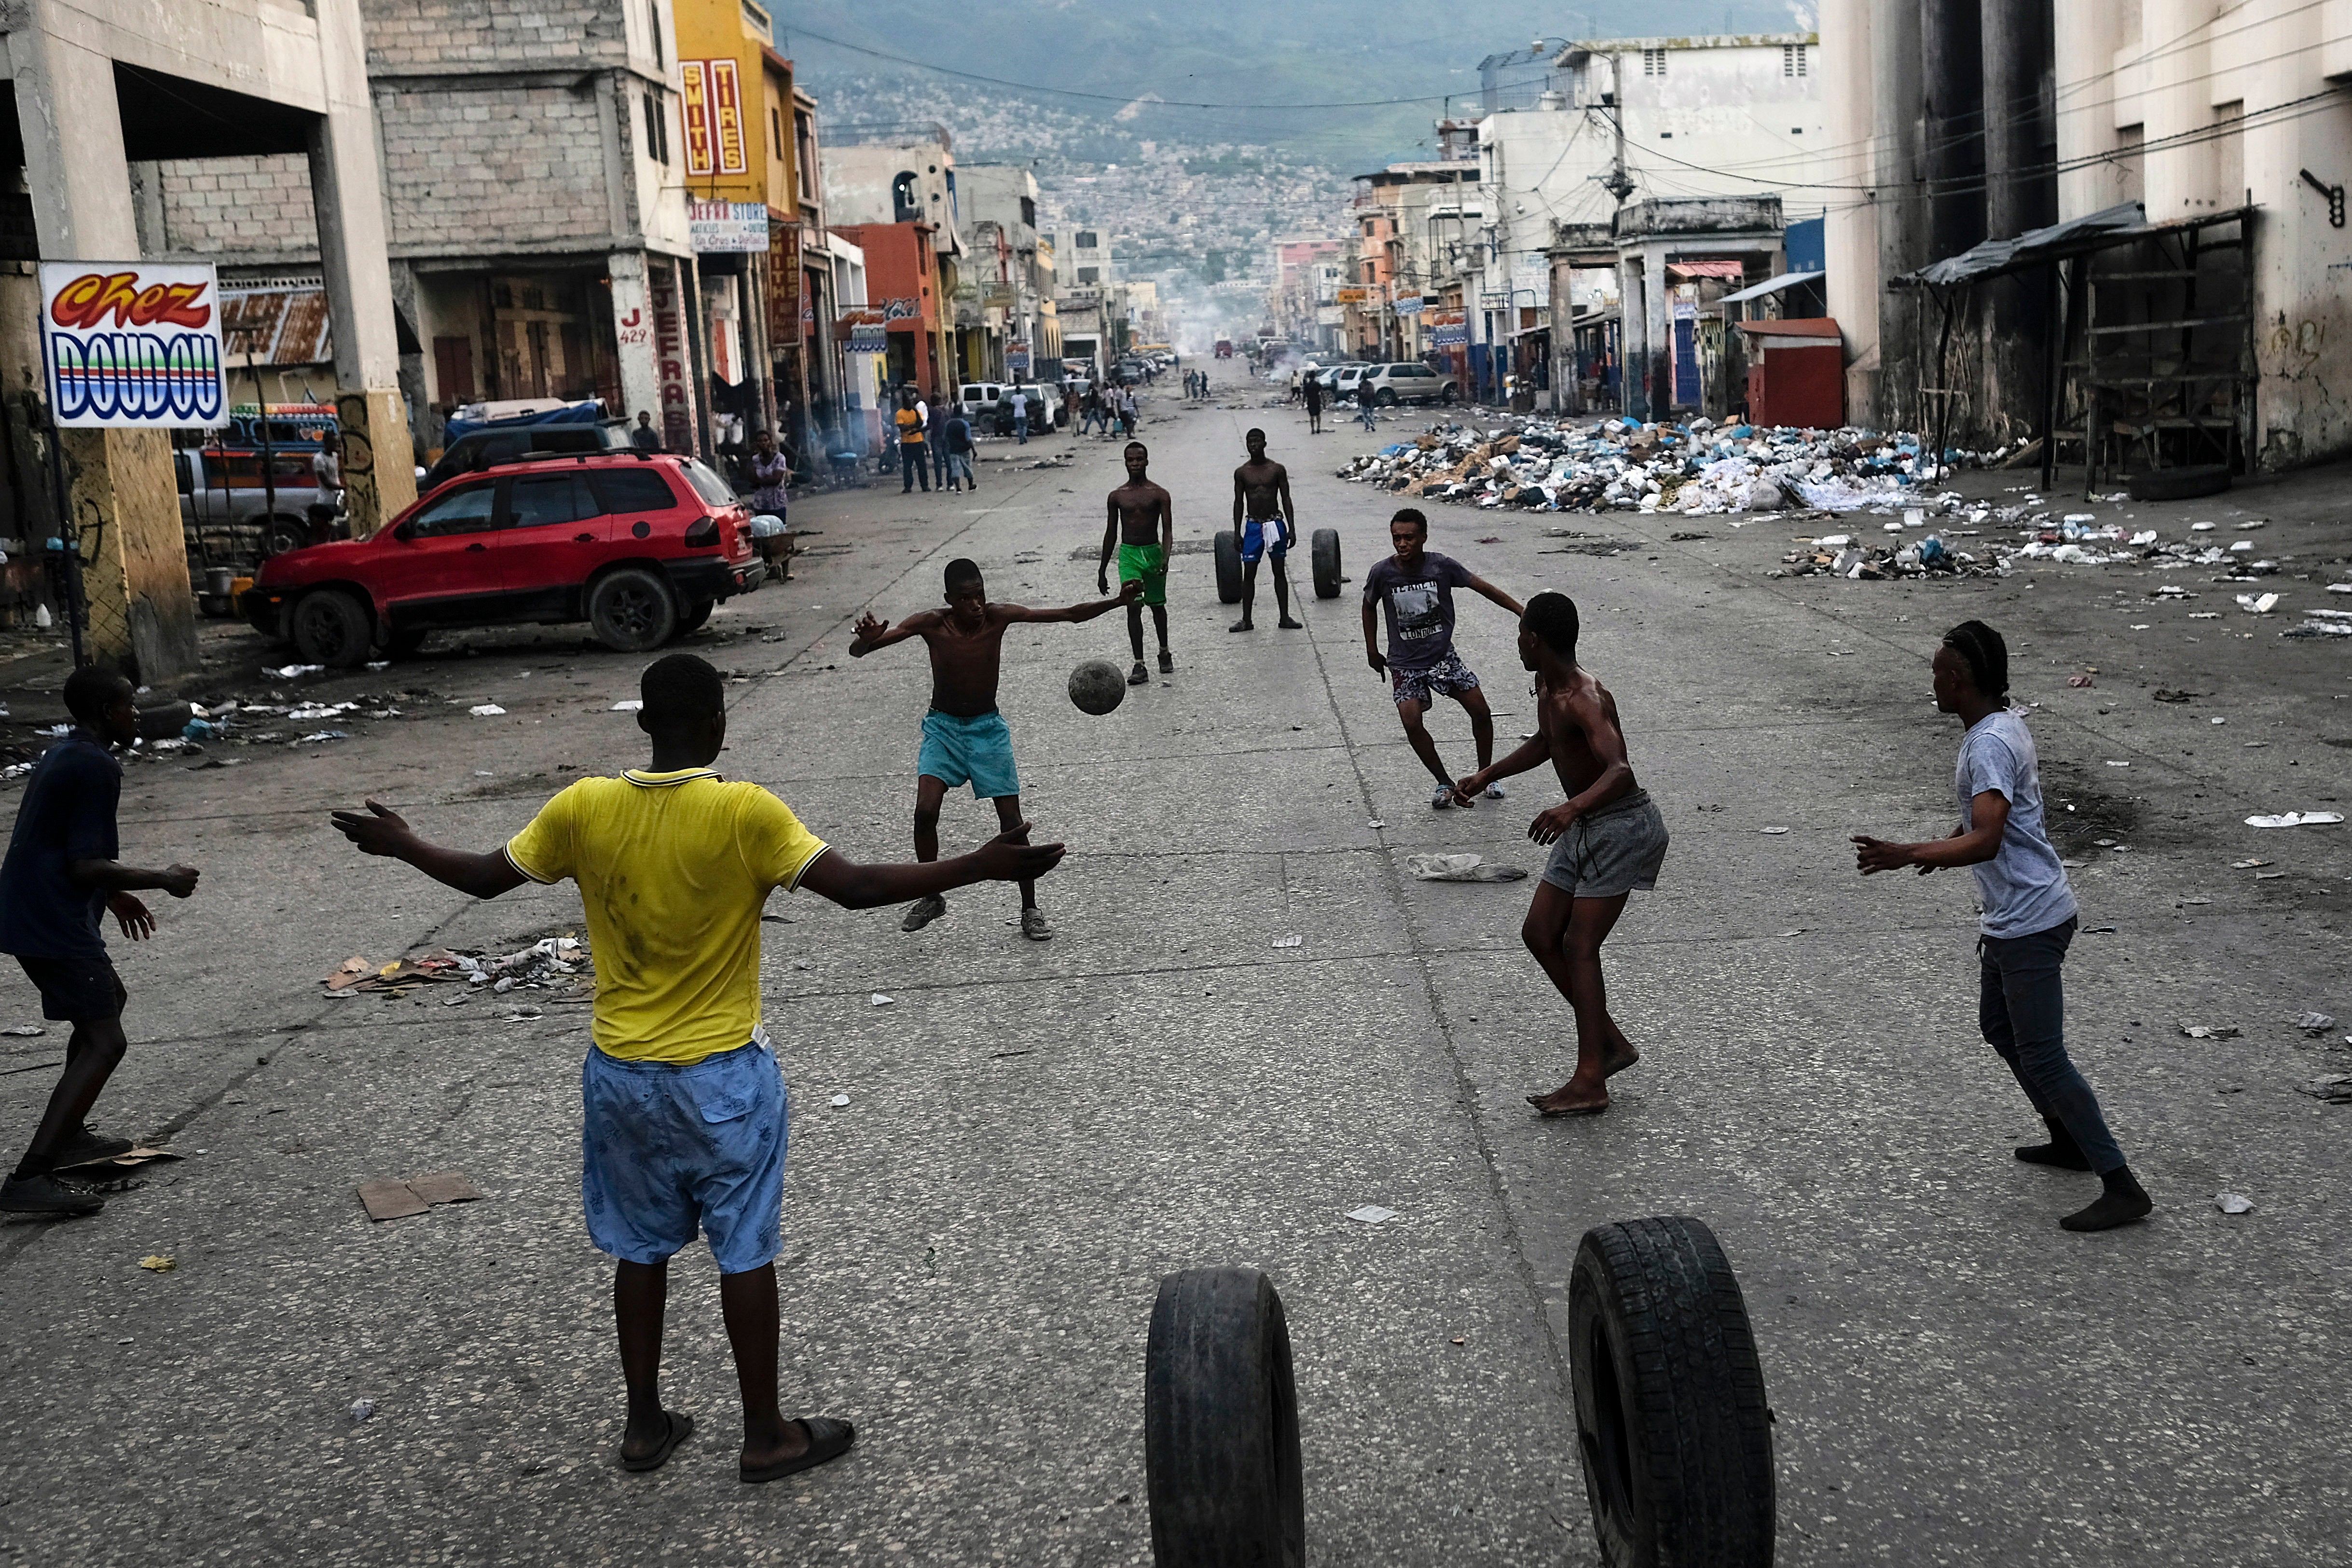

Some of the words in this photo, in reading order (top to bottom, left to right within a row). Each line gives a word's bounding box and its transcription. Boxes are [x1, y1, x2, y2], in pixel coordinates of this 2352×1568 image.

[684, 66, 709, 169] SMITH
[715, 65, 741, 168] TIRES
[733, 203, 767, 220] STORE
[51, 271, 211, 329] Chez
[621, 308, 641, 327] J
[619, 328, 647, 344] 429
[654, 287, 684, 404] JEFRA
[51, 332, 221, 420] DOUDOU
[1406, 625, 1437, 639] LONDON
